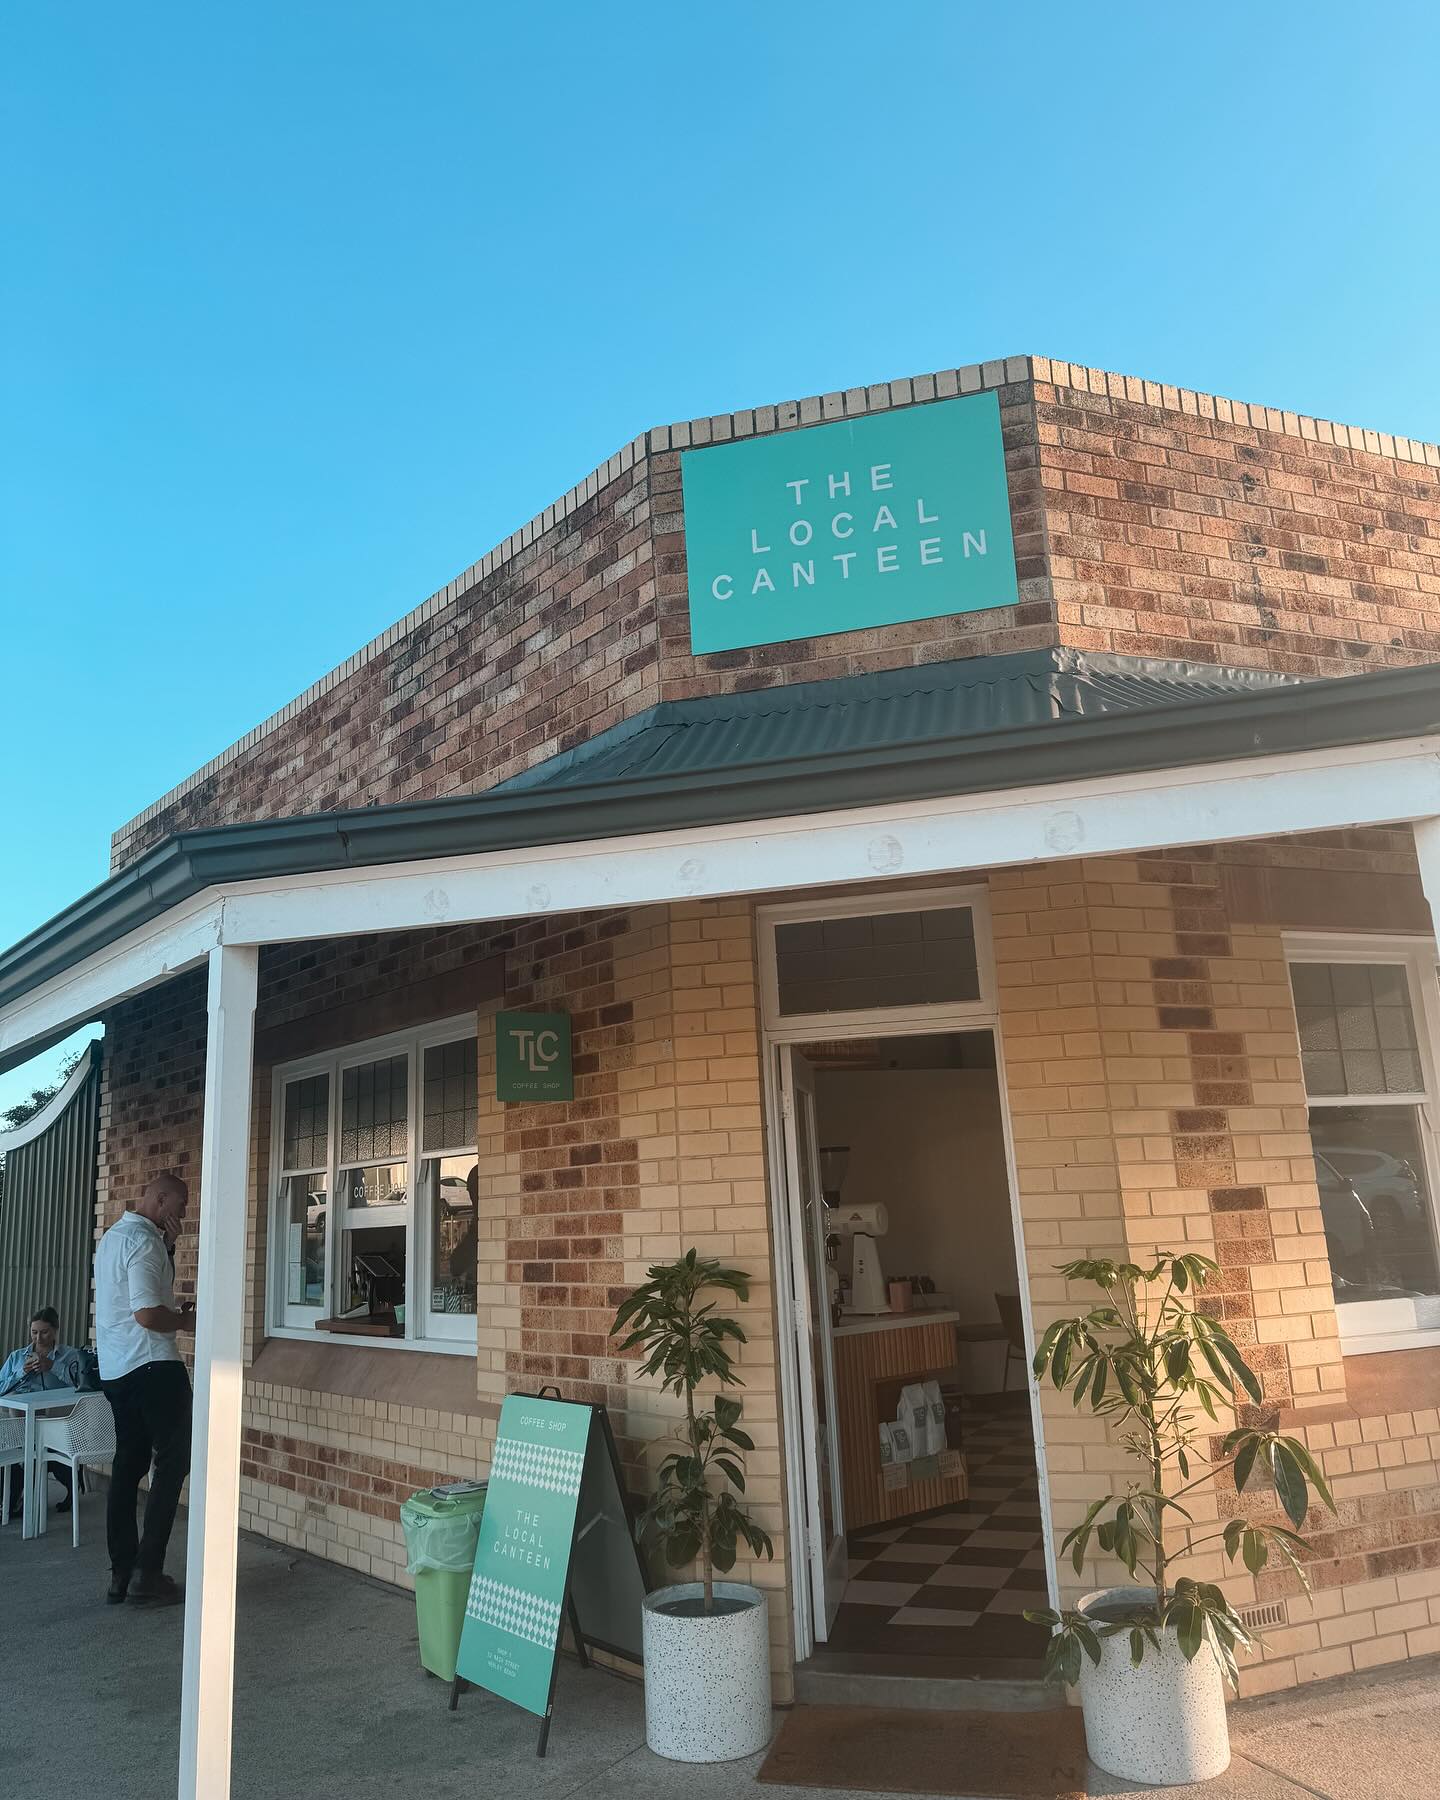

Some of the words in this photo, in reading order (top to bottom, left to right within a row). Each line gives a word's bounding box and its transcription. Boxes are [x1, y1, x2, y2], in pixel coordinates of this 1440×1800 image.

[786, 463, 894, 505] THE
[750, 498, 939, 555] LOCAL
[711, 528, 988, 601] CANTEEN
[509, 1030, 560, 1072] TLC
[520, 1415, 545, 1428] COFFEE
[548, 1420, 567, 1433] SHOP
[504, 1524, 544, 1548] LOCAL
[516, 1509, 541, 1528] THE
[493, 1540, 551, 1570] CANTEEN
